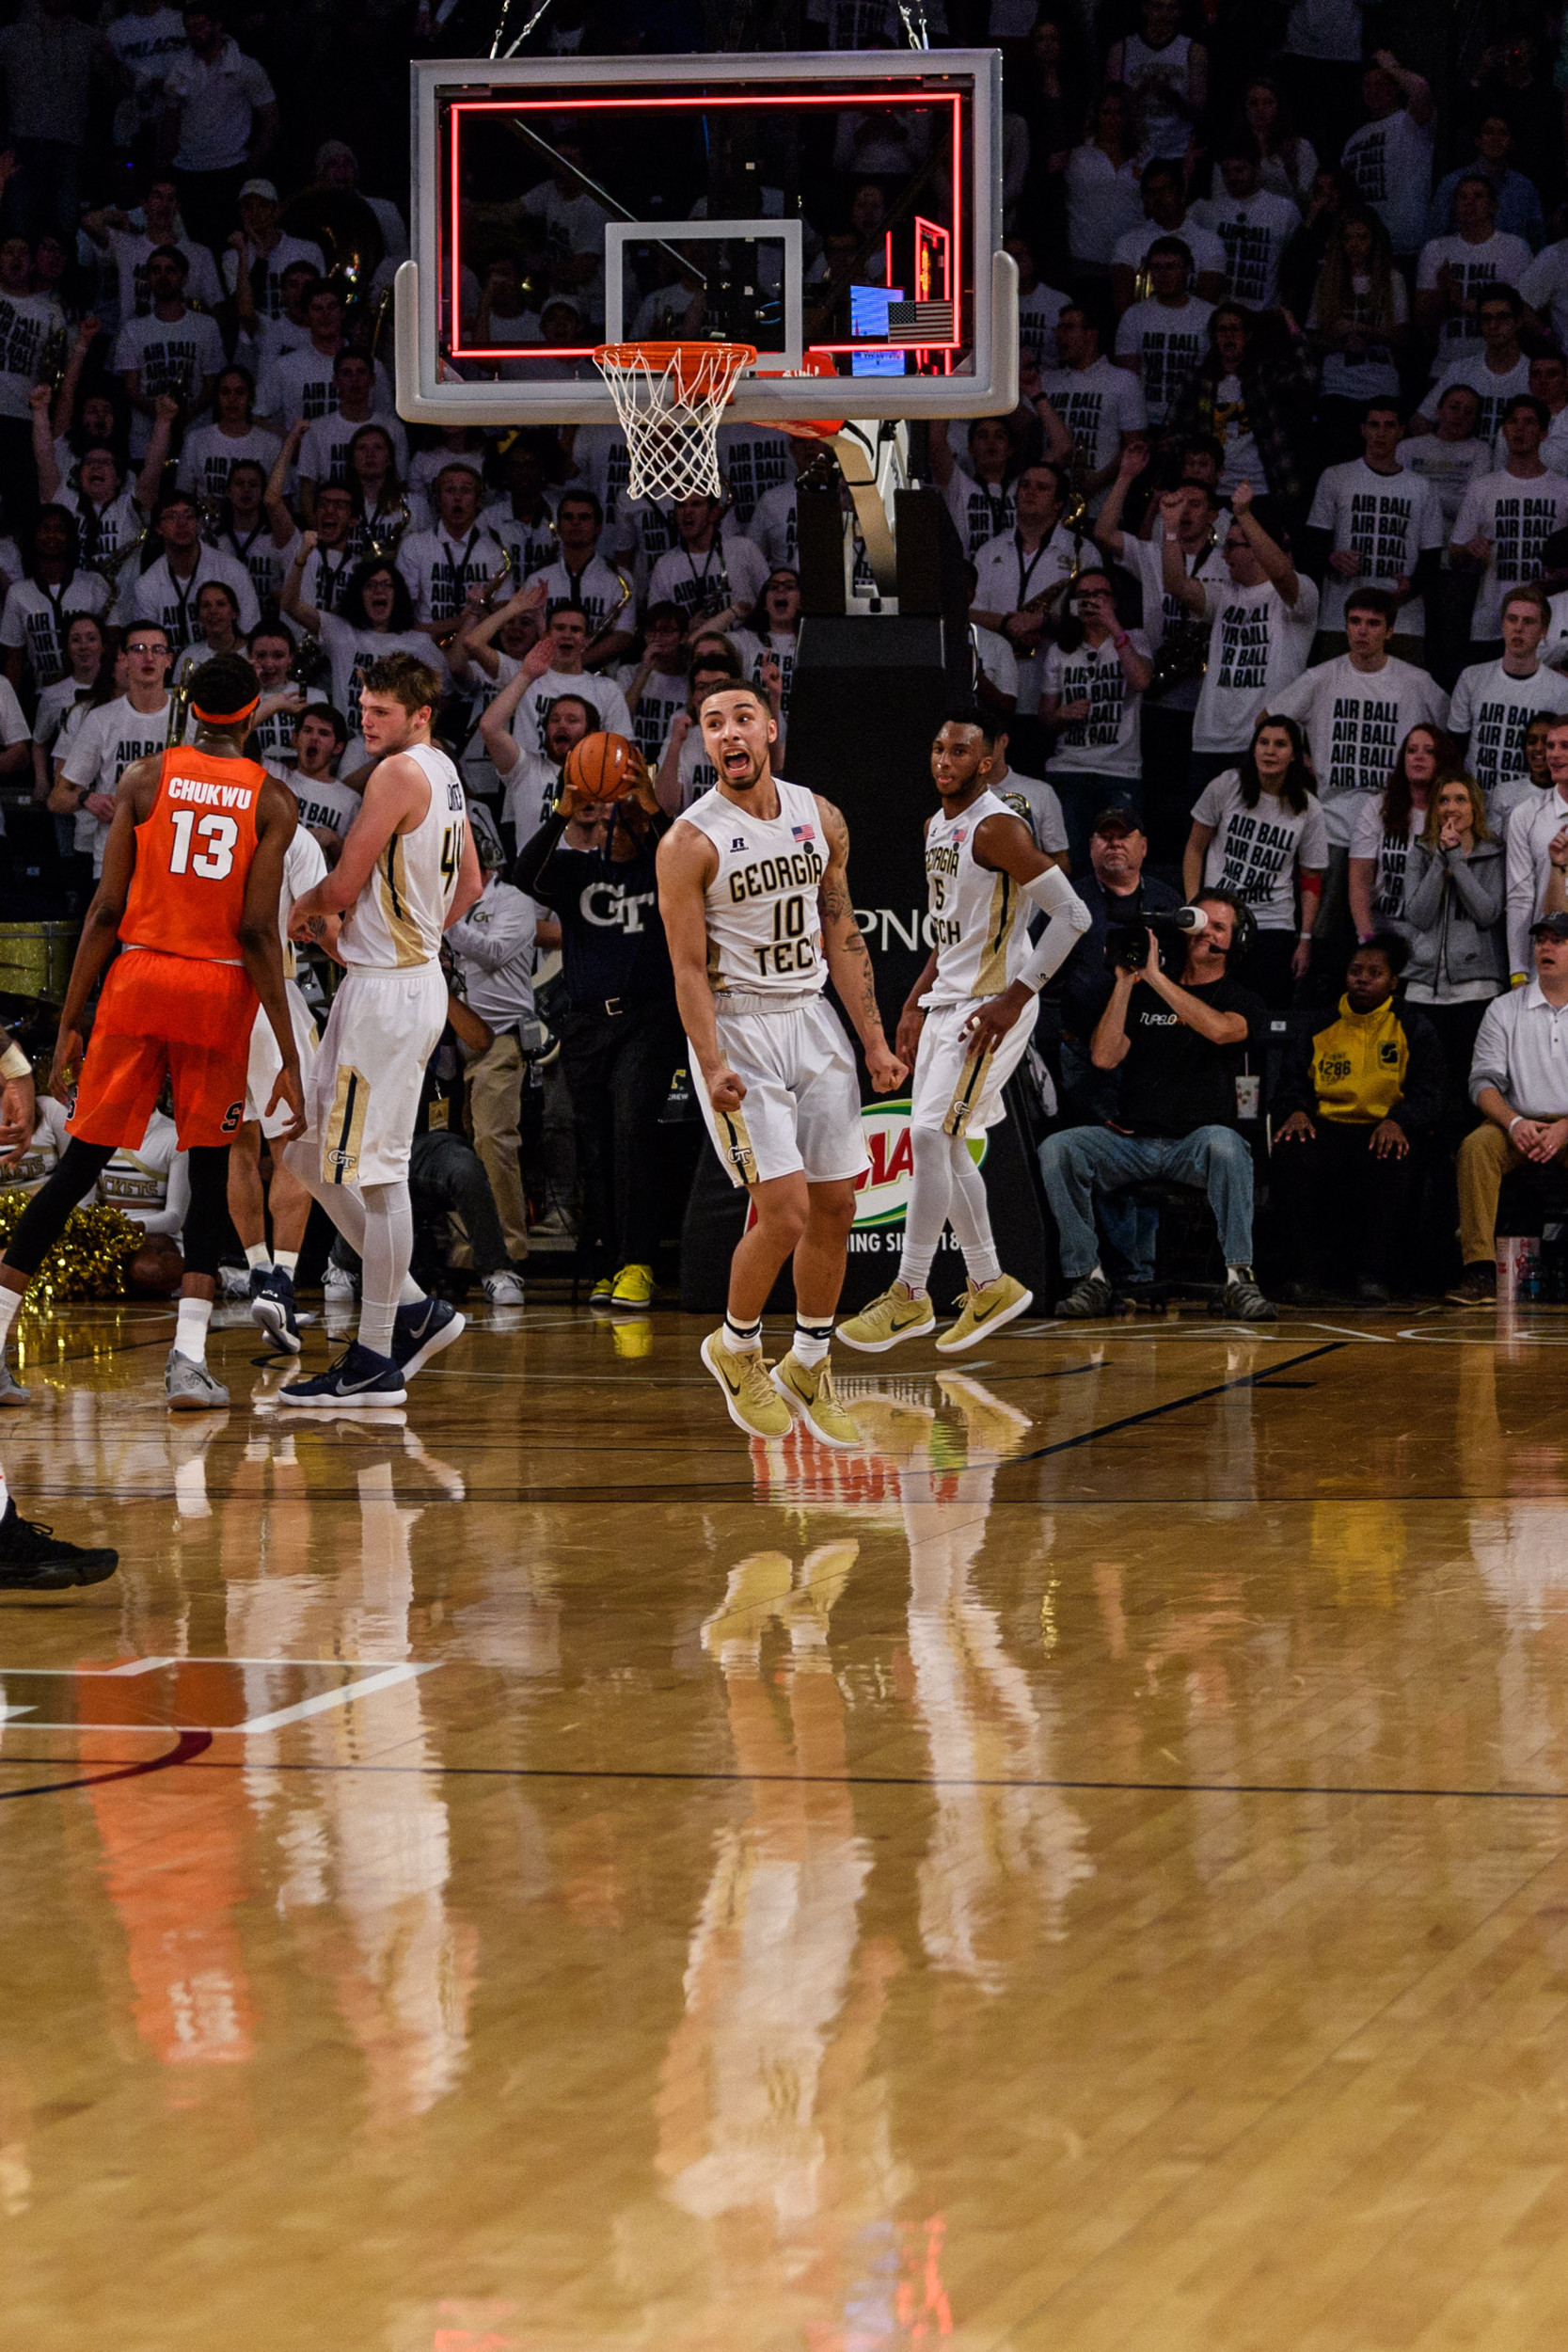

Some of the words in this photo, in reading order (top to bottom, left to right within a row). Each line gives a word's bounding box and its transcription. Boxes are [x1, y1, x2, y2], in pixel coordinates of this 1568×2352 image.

[1468, 262, 1496, 280] BALL
[303, 382, 325, 400] AIR
[1071, 392, 1101, 409] BALL
[1069, 411, 1100, 430] BALL
[729, 444, 751, 462] AIR
[753, 440, 786, 459] BALL
[1075, 431, 1098, 451] ALL
[730, 464, 752, 482] AIR
[755, 461, 786, 480] BALL
[1352, 494, 1376, 513] AIR
[1380, 496, 1411, 518] BALL
[1496, 500, 1520, 517] AIR
[1523, 500, 1556, 518] BALL
[1352, 515, 1375, 534] AIR
[1496, 519, 1519, 538] AIR
[1377, 537, 1407, 560] BALL
[27, 613, 49, 631] AIR
[1241, 625, 1269, 646] BALL
[1237, 646, 1268, 666] BALL
[1234, 669, 1266, 688] BALL
[1092, 682, 1124, 703] BALL
[636, 698, 660, 717] AIR
[1091, 704, 1122, 723] BALL
[1334, 698, 1359, 720] AIR
[1363, 701, 1399, 723] BALL
[1479, 703, 1504, 723] AIR
[635, 719, 659, 740] AIR
[1089, 726, 1119, 745] BALL
[1332, 722, 1357, 742] AIR
[1361, 723, 1397, 746] BALL
[1478, 725, 1501, 745] AIR
[117, 741, 141, 761] AIR
[1331, 744, 1355, 765] AIR
[1359, 746, 1396, 770] BALL
[1476, 747, 1497, 769] AIR
[1330, 767, 1355, 787] AIR
[1476, 769, 1497, 789] AIR
[167, 777, 252, 810] CHUKWU
[307, 803, 341, 831] BALL
[1227, 814, 1257, 840] AIR
[1258, 818, 1294, 851] BALL
[168, 808, 239, 882] 13
[1224, 836, 1249, 862] AIR
[1250, 843, 1287, 871] BALL
[1383, 853, 1406, 874] AIR
[729, 852, 823, 903] GEORGIA
[1243, 864, 1277, 889] BALL
[934, 879, 945, 911] 5
[578, 882, 655, 935] GT
[774, 896, 804, 942] 10
[1140, 1011, 1178, 1026] TUPELO
[1319, 1060, 1352, 1075] 4286
